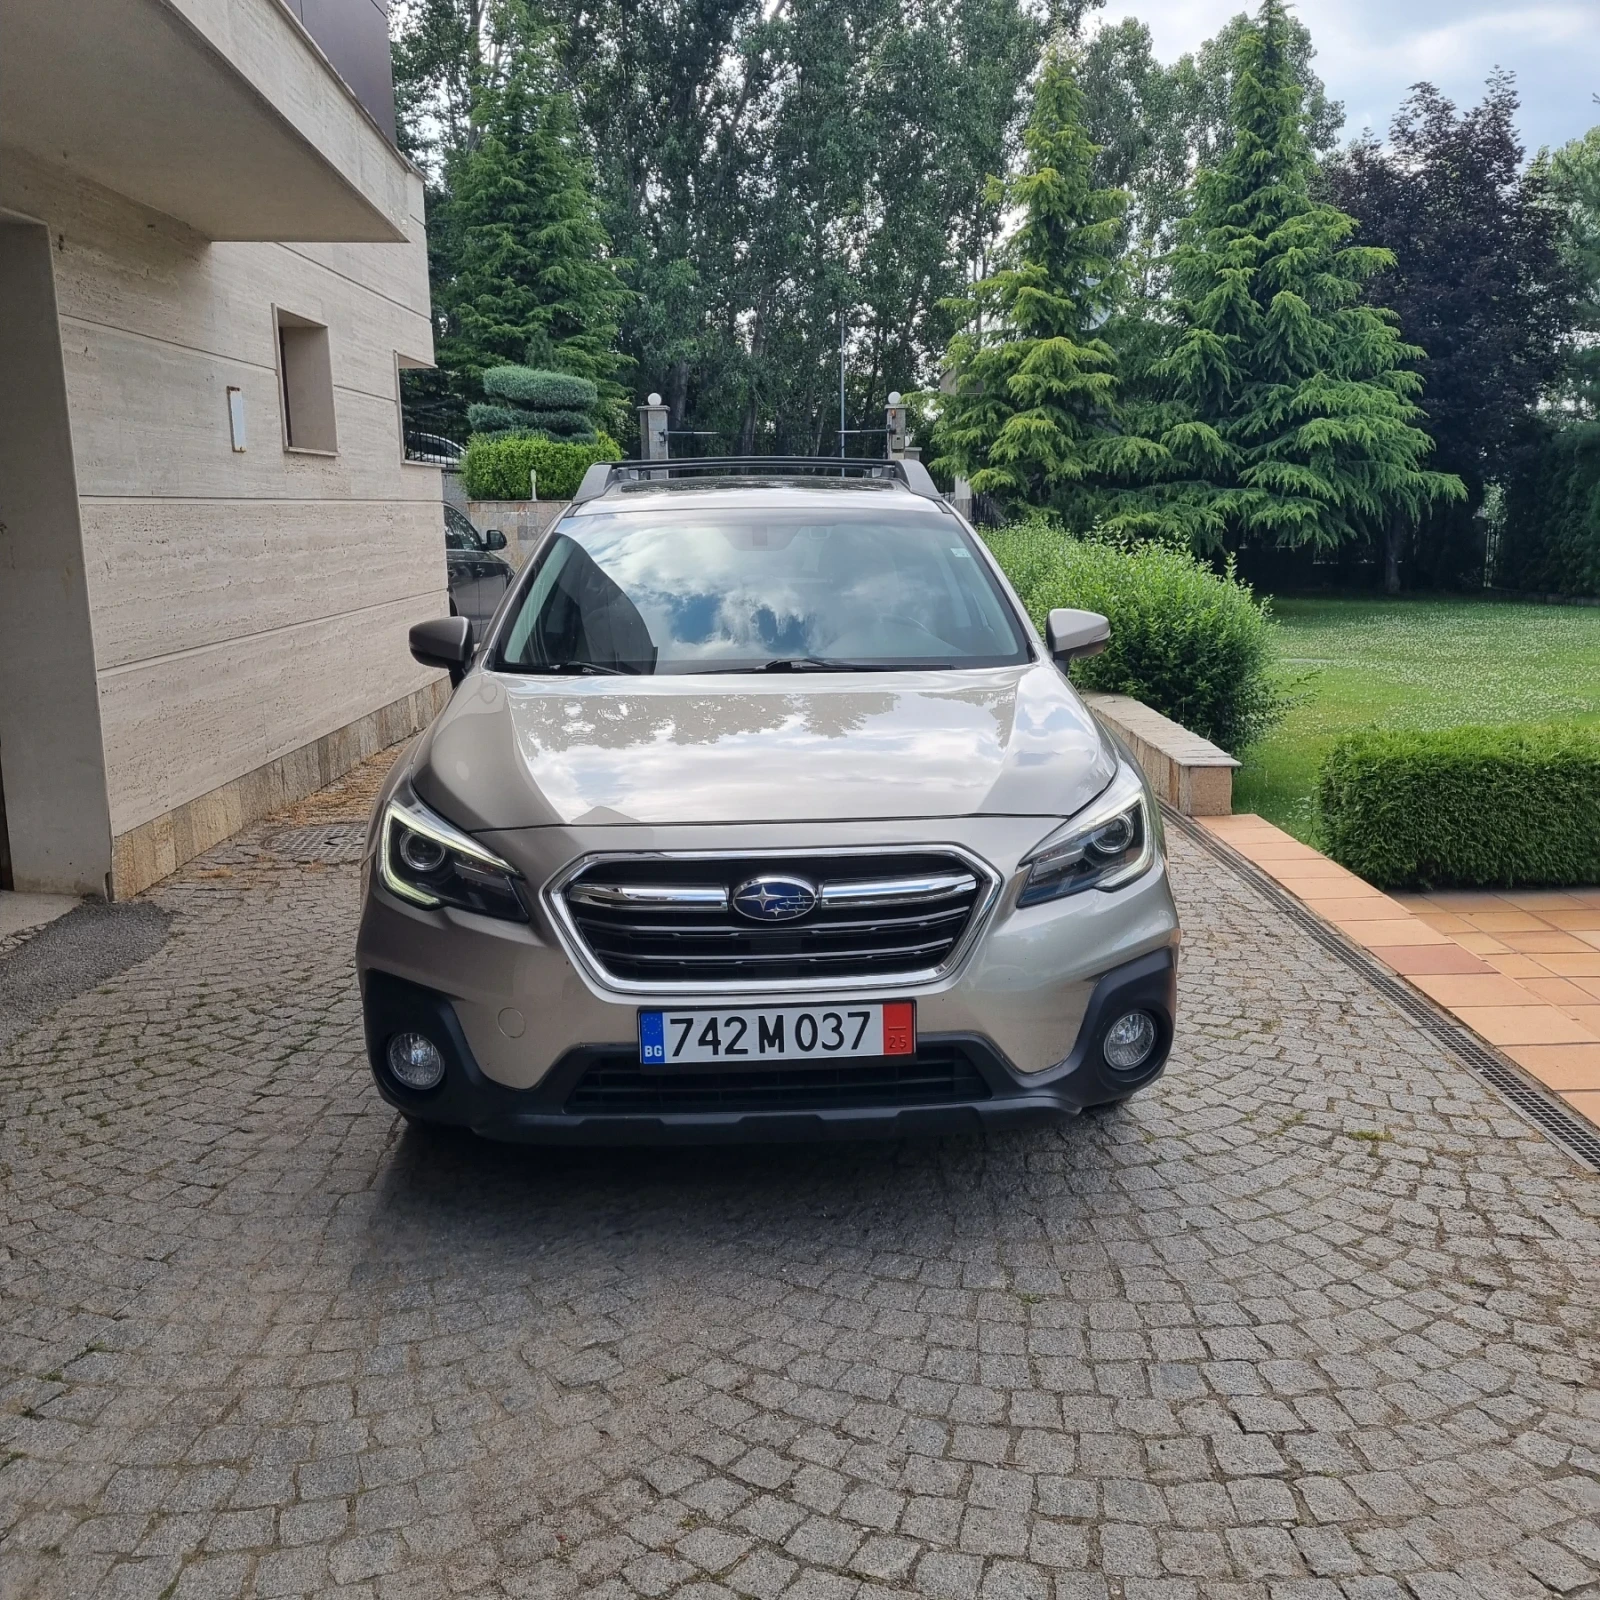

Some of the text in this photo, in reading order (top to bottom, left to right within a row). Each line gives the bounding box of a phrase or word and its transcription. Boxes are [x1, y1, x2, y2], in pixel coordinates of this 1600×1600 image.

[670, 1011, 870, 1057] 742 M 037
[889, 1035, 907, 1049] 25
[644, 1044, 662, 1057] BG
